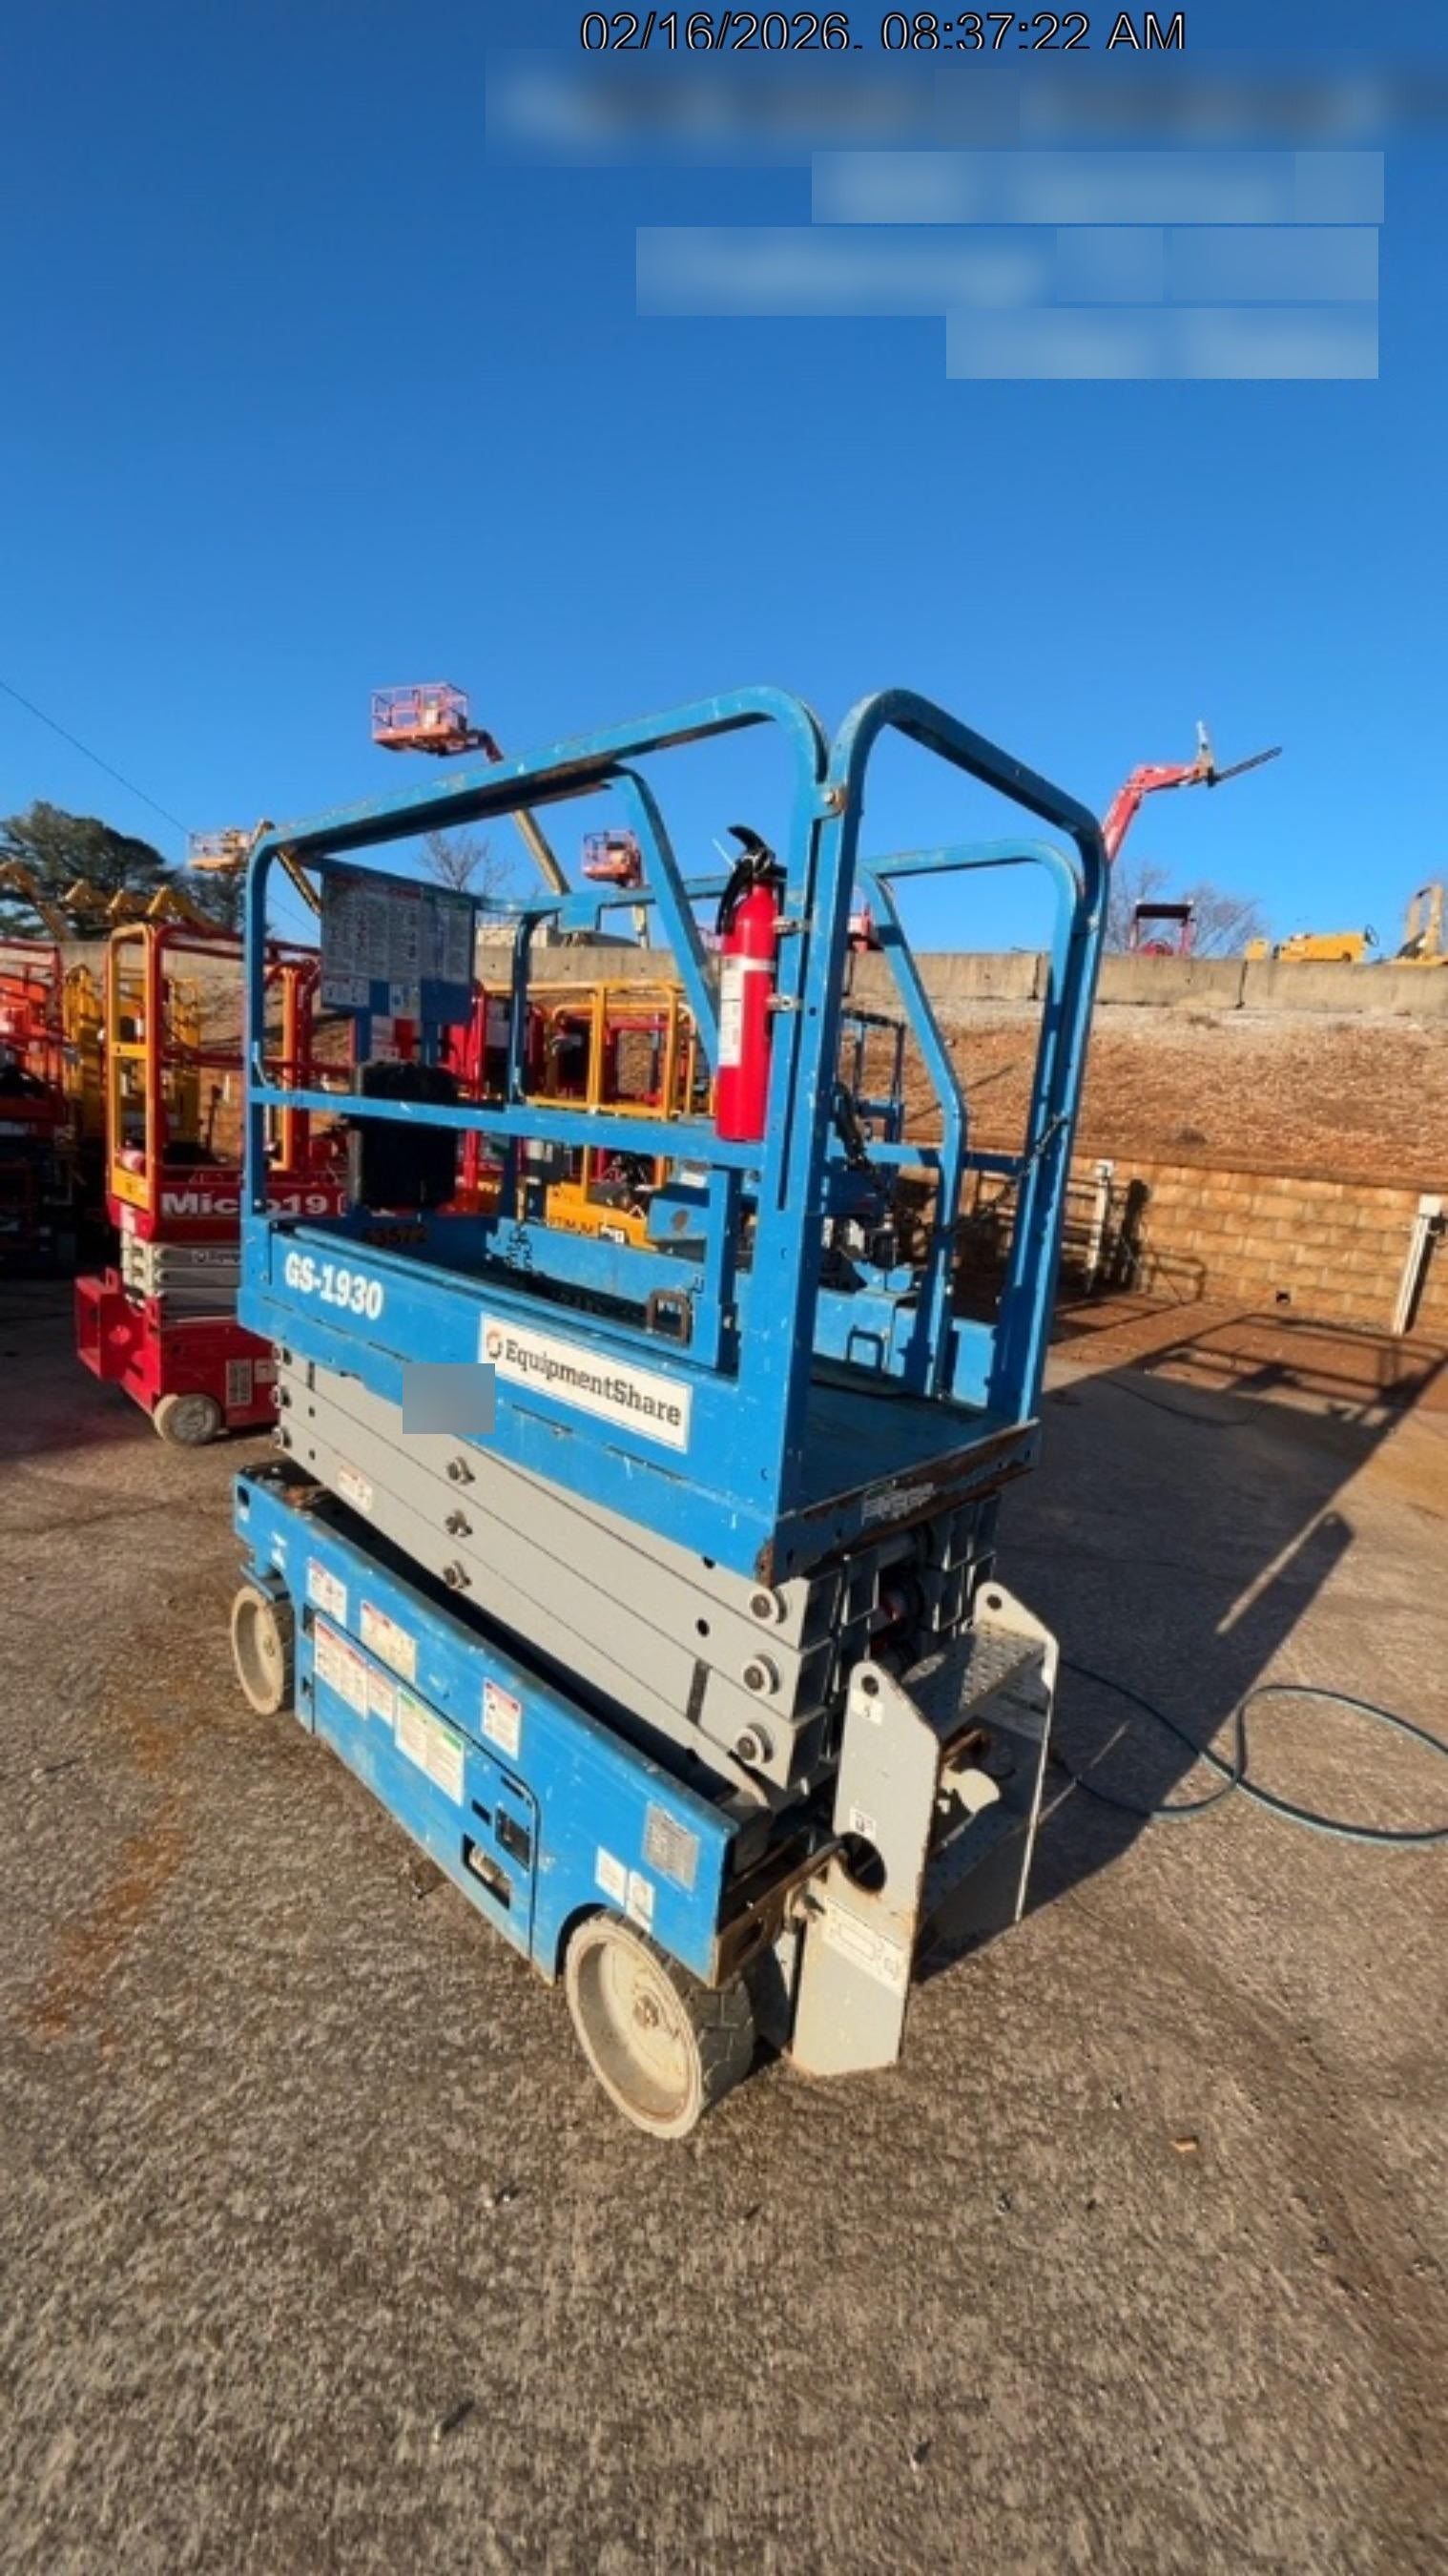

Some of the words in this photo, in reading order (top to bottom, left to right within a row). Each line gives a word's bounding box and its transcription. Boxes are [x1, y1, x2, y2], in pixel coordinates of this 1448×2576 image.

[159, 1193, 328, 1216] Mico19
[285, 1251, 383, 1320] GS-1930
[506, 1339, 681, 1426] EquipmentShare
